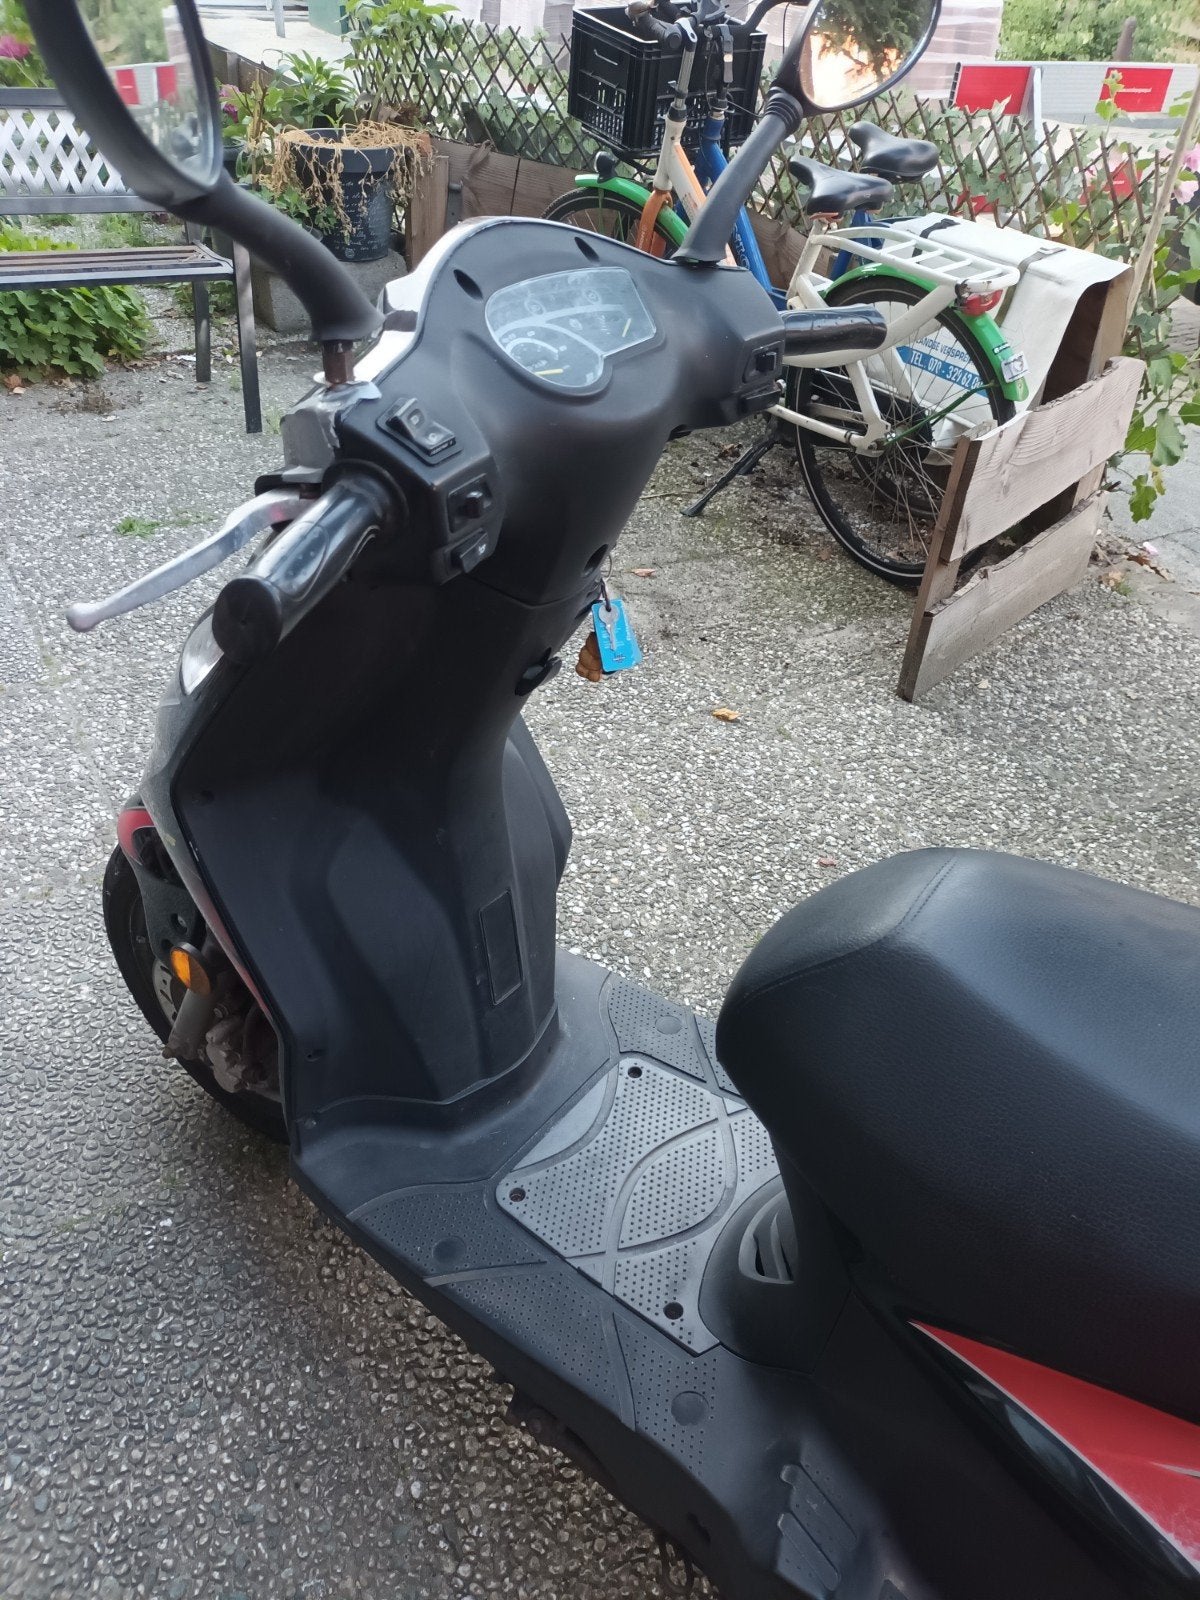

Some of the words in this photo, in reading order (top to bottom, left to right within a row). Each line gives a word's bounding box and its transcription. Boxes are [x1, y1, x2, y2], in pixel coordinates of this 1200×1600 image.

[910, 350, 925, 368] TEL.
[927, 357, 942, 374] 070
[961, 373, 973, 387] 62
